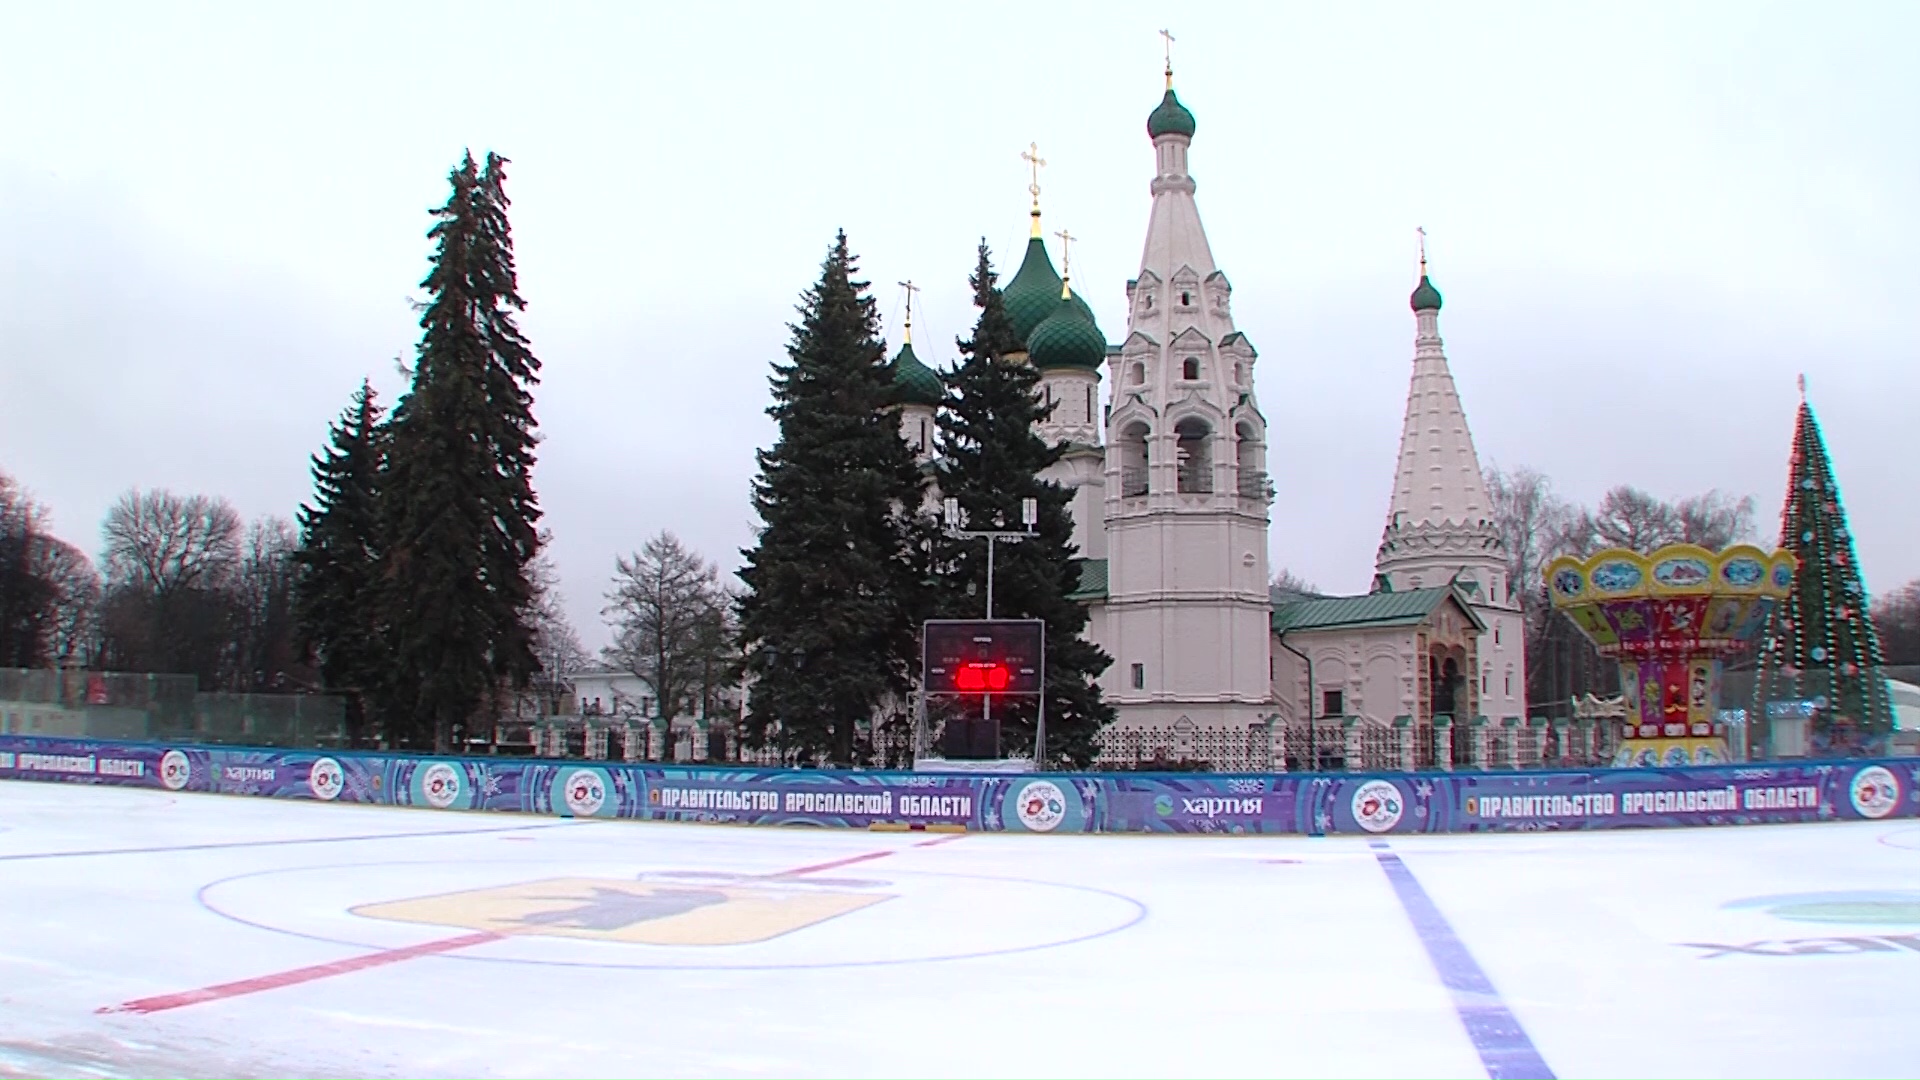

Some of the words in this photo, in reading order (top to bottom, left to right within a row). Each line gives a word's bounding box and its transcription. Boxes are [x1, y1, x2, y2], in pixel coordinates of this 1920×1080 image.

[225, 765, 276, 783] хартия
[661, 787, 779, 811] ПРАВИТЕЛЬСТВО
[785, 791, 892, 815] ЯРОСЛАВСКОЙ
[899, 794, 972, 817] ОБЛАСТИ
[1181, 796, 1264, 819] хартия
[1479, 793, 1616, 818] ПРАВИТЕЛЬСТВО
[1622, 785, 1738, 814] ЯРОСЛАВСКОЙ
[1744, 786, 1818, 810] ОБЛАСТИ
